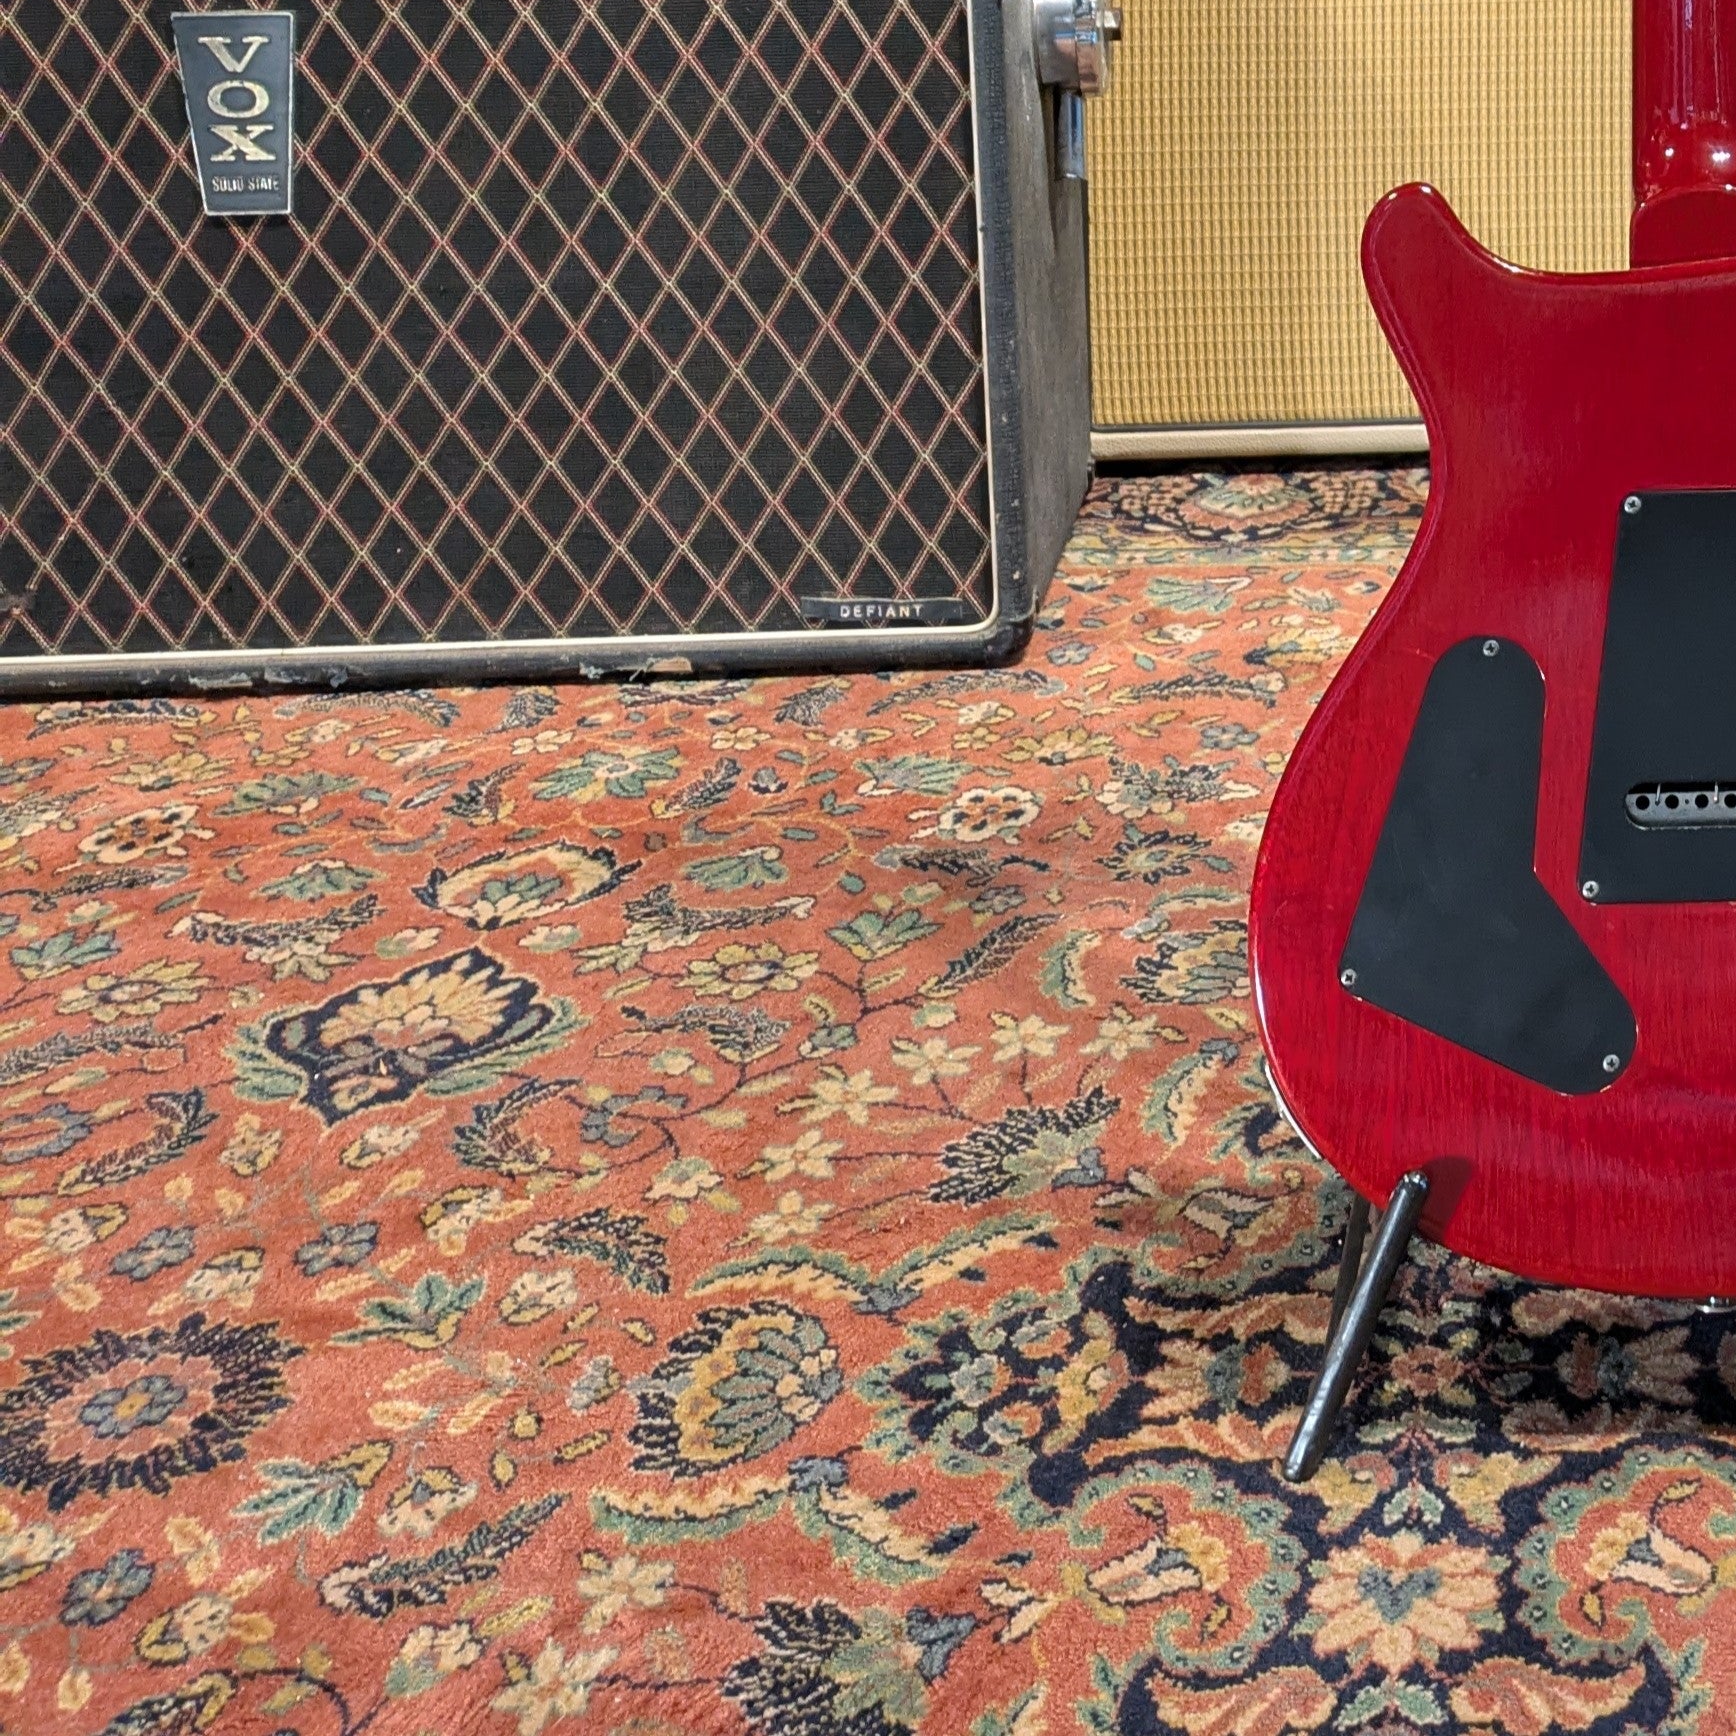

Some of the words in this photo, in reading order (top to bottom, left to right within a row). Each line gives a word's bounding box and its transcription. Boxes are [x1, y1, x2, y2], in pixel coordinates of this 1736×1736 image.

[197, 36, 277, 162] VOX
[211, 175, 244, 193] SOLID
[247, 175, 280, 193] STATE
[839, 604, 923, 619] DEFIANT
